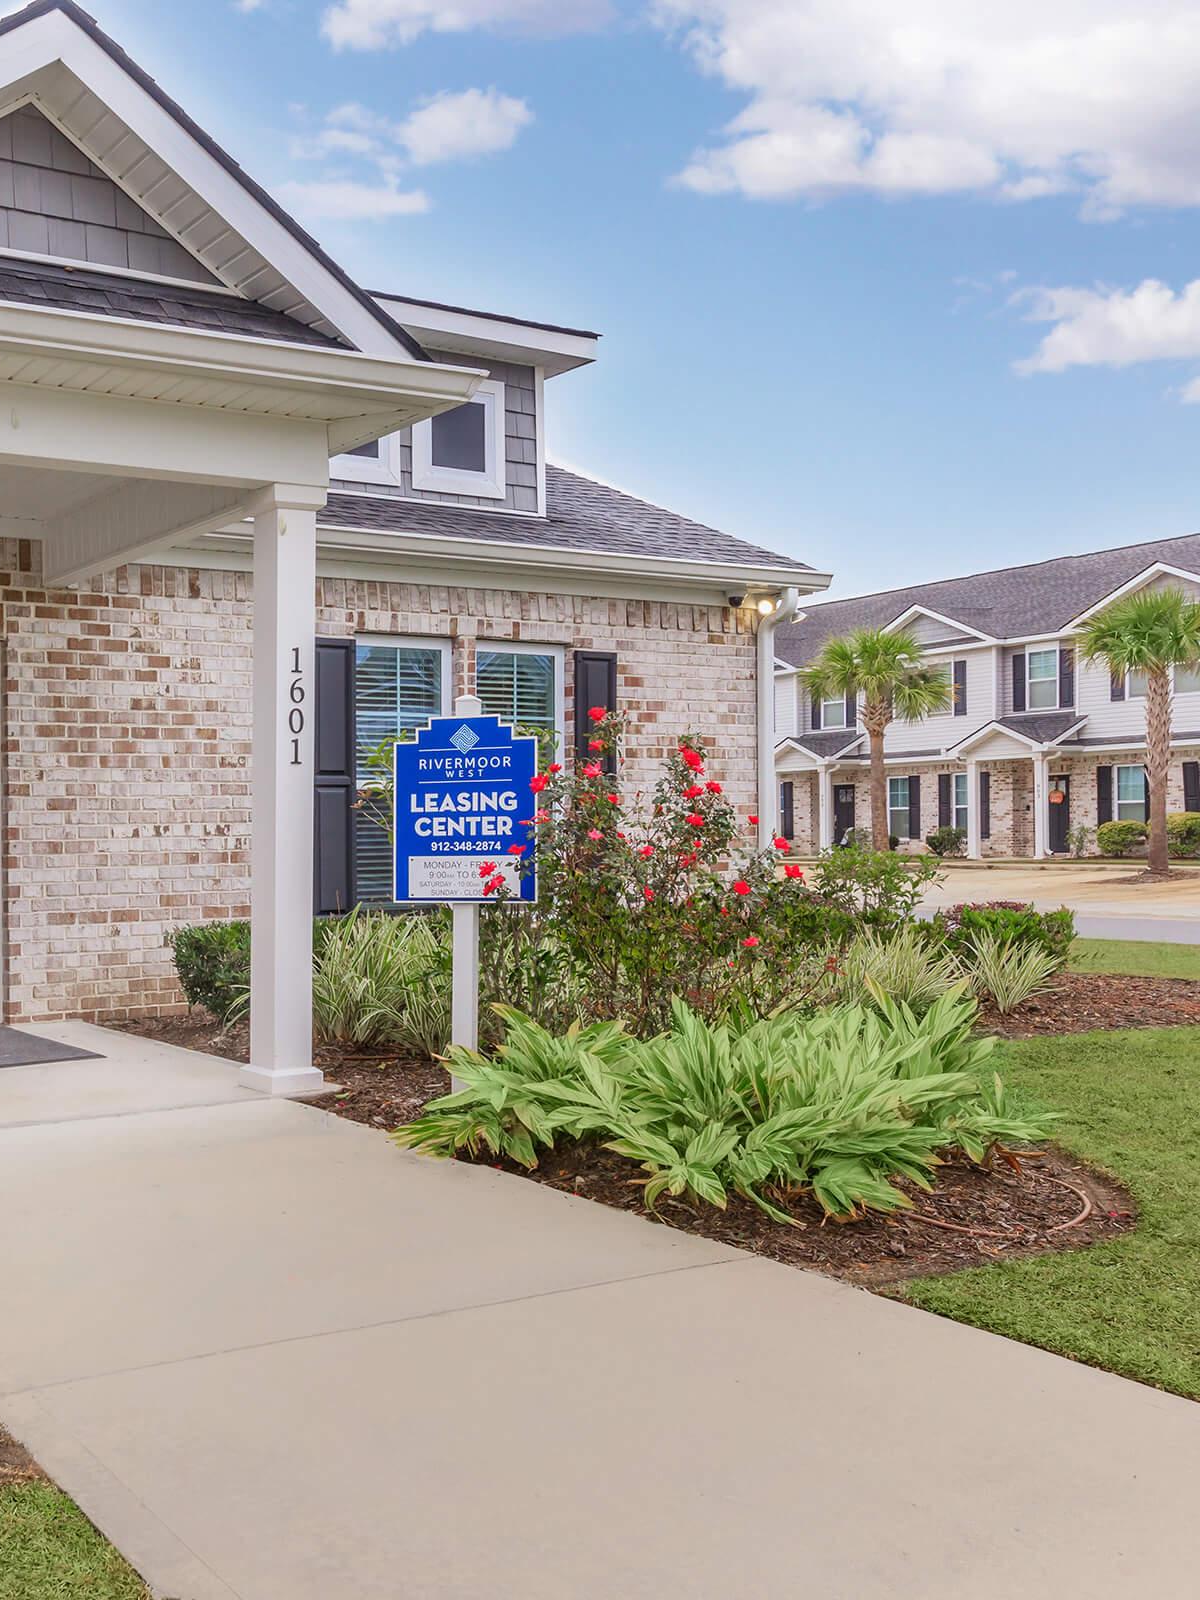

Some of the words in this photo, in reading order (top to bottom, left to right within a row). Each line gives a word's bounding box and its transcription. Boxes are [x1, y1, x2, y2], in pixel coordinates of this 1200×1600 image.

[288, 647, 305, 765] 1601
[419, 756, 512, 770] RIVERMOOR
[445, 769, 484, 778] WEST
[410, 791, 518, 813] LEASING
[414, 816, 513, 837] CENTER
[431, 841, 501, 852] 912-348-2874
[423, 861, 462, 869] MONDAY
[470, 861, 503, 869] FRY
[429, 871, 455, 879] 9:00
[457, 871, 469, 879] TO
